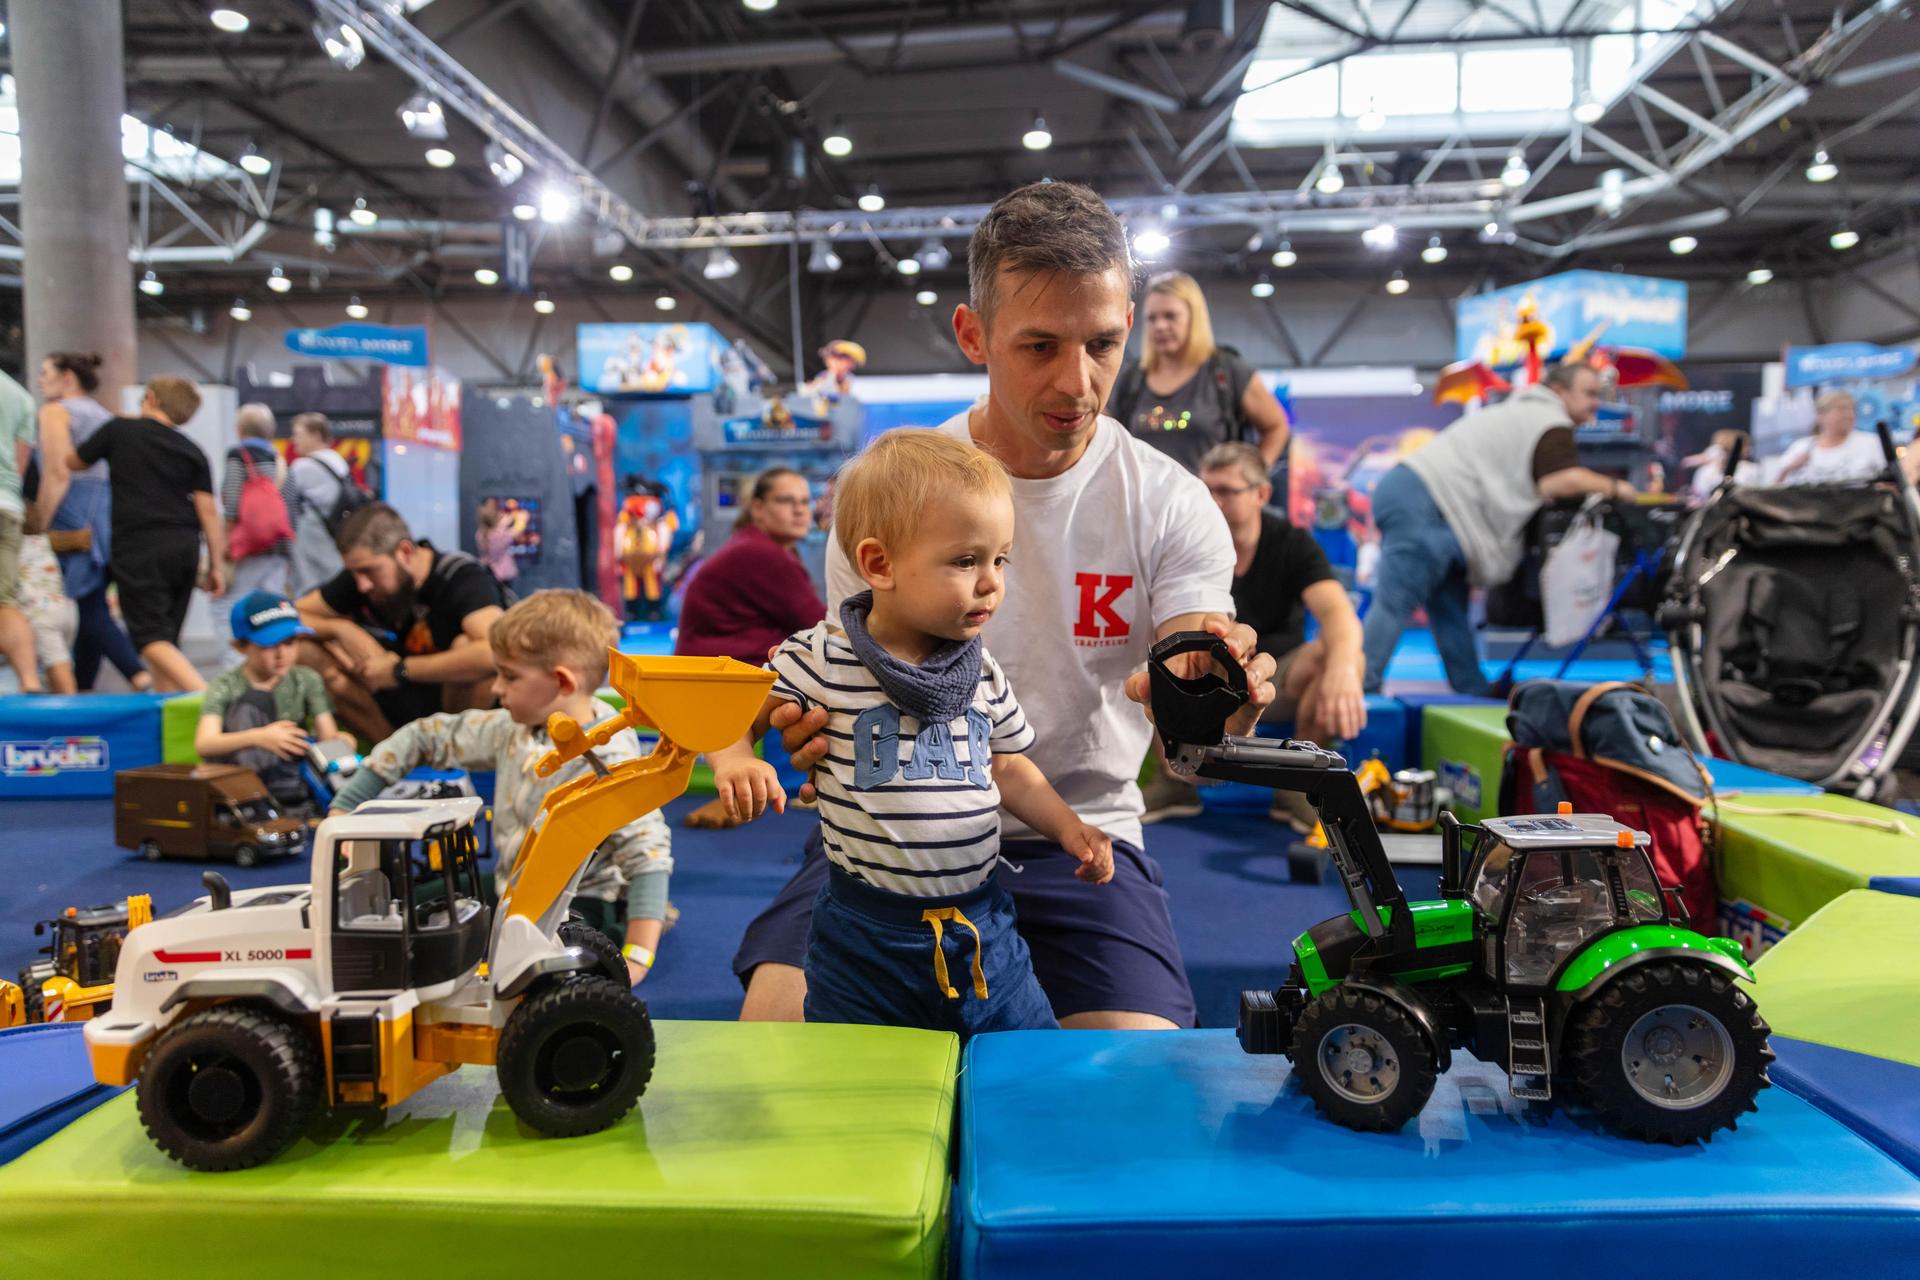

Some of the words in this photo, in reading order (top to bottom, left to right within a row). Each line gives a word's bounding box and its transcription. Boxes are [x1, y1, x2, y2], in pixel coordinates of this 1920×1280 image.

[1074, 572, 1133, 638] K
[5, 743, 100, 768] bruder
[852, 703, 991, 790] GAP
[224, 950, 242, 962] XL
[247, 949, 284, 961] 5000
